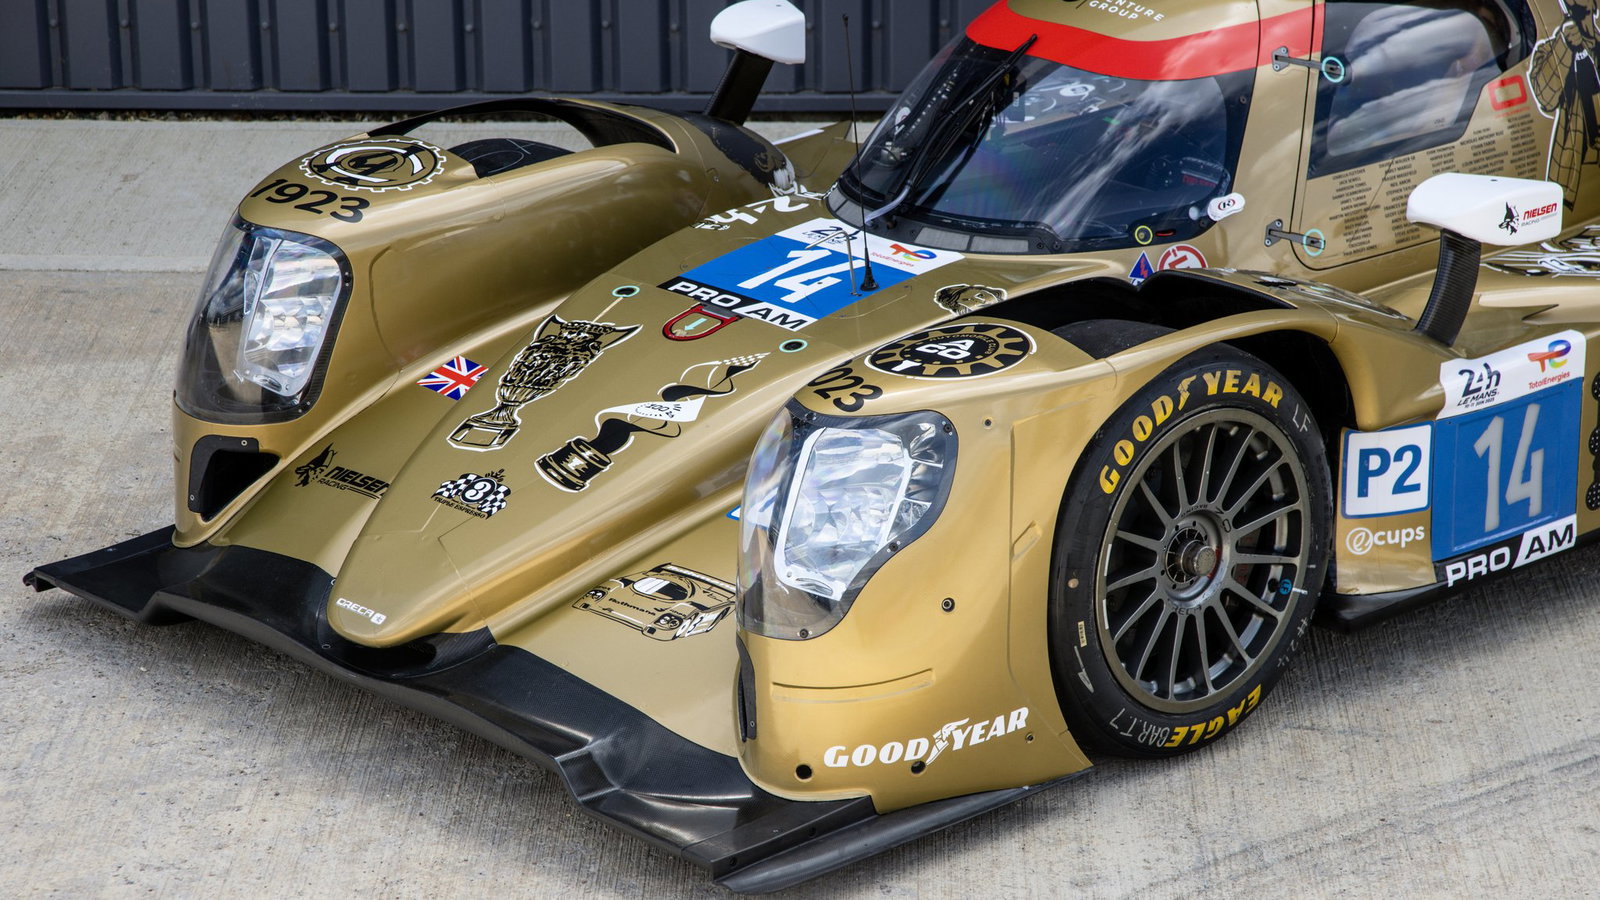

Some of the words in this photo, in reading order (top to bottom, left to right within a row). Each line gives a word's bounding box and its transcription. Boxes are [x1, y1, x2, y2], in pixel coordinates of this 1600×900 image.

[1089, 0, 1139, 20] GROUP
[1106, 0, 1165, 21] NTURE
[250, 178, 370, 223] 1923
[1523, 203, 1557, 220] NIELSEN
[737, 249, 867, 304] 14
[668, 281, 741, 308] PRO
[745, 307, 808, 330] AM
[807, 359, 884, 412] 023
[1458, 362, 1501, 398] 24h
[1528, 371, 1571, 390] TotalEnergies
[319, 478, 347, 491] RACING
[1357, 444, 1422, 498] P2
[1473, 403, 1544, 533] 14
[464, 481, 492, 501] 3
[454, 504, 486, 519] ESPRESSO
[1445, 546, 1511, 588] PRO
[1525, 523, 1574, 560] AM
[1164, 684, 1262, 748] EAGLE
